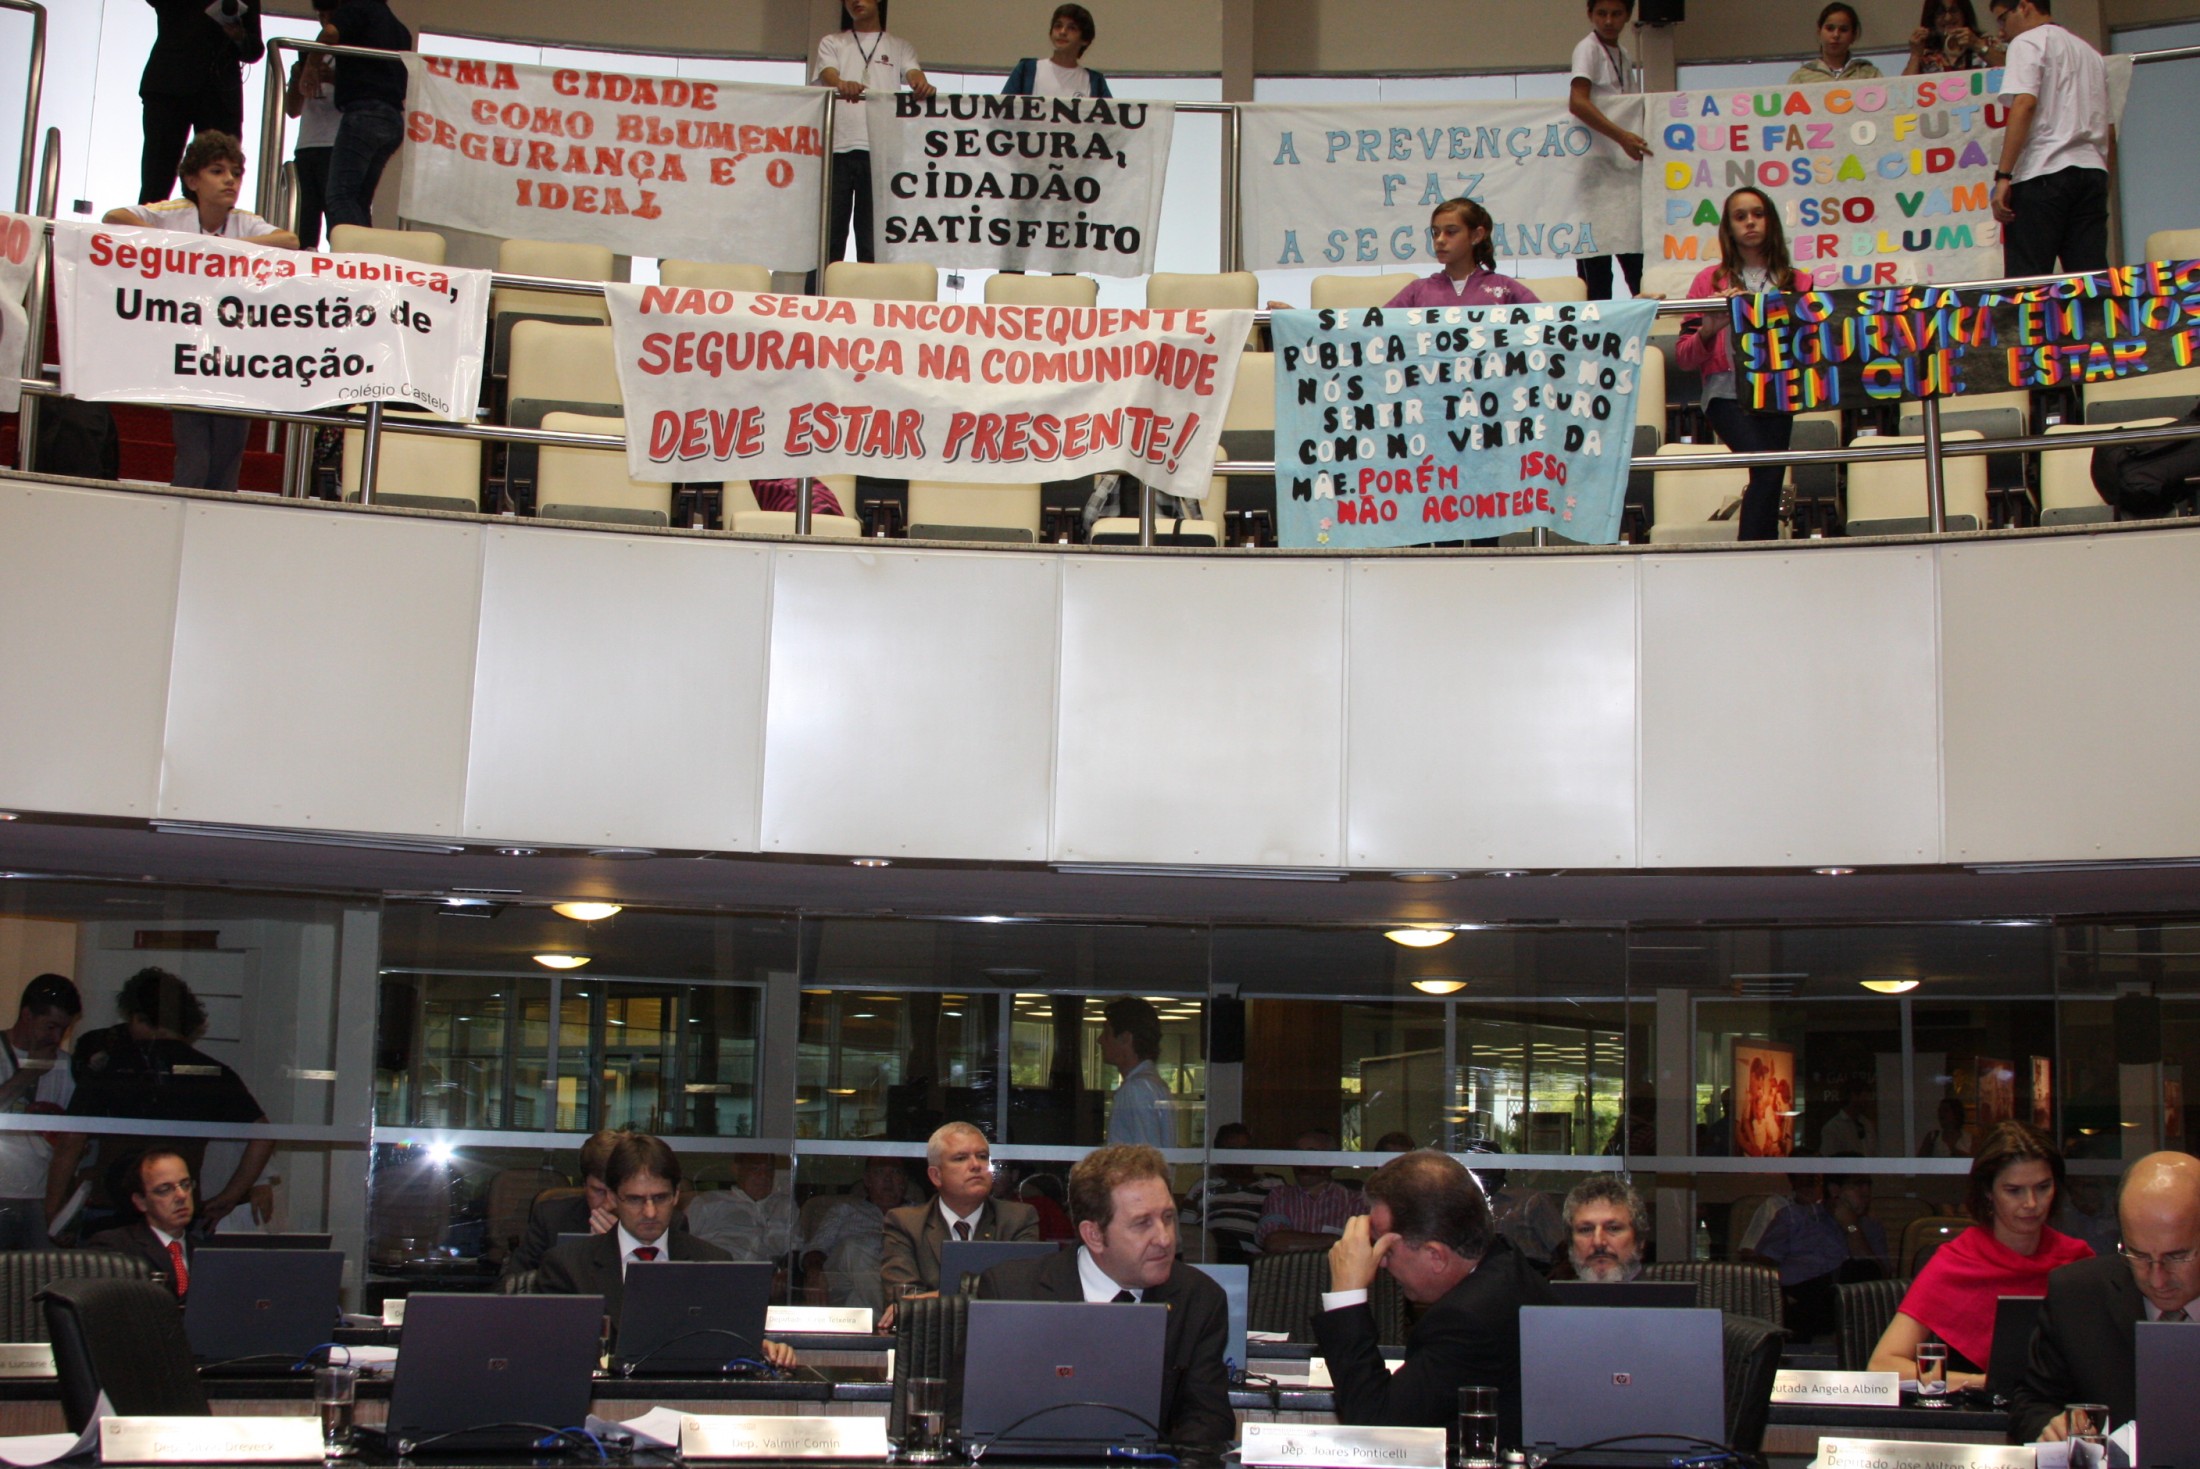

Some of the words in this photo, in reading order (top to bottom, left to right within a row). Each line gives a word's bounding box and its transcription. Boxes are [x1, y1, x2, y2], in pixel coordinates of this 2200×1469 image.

[421, 55, 520, 90] UMA
[552, 69, 719, 111] CIDADE
[471, 99, 594, 140] COMO
[895, 92, 1148, 129] BLUMENAU
[1669, 92, 1689, 118] É
[1701, 95, 1720, 117] A
[1731, 91, 1812, 118] SUA
[407, 111, 687, 186] SEGURANÇA
[710, 152, 748, 187] É
[765, 159, 795, 189] O
[924, 129, 1127, 168] SEGURA,
[1273, 132, 1300, 165] A
[1325, 120, 1592, 166] PREVENÇÃO
[1663, 123, 1750, 152] QUE
[1763, 123, 1834, 152] FAZ
[1850, 120, 1877, 147] O
[1665, 159, 1713, 191] DA
[1726, 153, 1866, 188] NOSSA
[1877, 138, 2001, 180] CIDA
[516, 179, 662, 220] IDEAL
[1382, 171, 1484, 206] FAZ
[1895, 182, 1996, 218] VAM
[1277, 230, 1303, 264] A
[1324, 222, 1599, 262] SEGANÇA
[1664, 233, 1838, 262] MAER
[89, 233, 296, 286] Segurança
[311, 256, 459, 304] Pública,
[1801, 262, 1934, 287] GURA!
[116, 287, 204, 326] Uma
[217, 295, 377, 329] Questão
[390, 301, 432, 334] de
[749, 294, 857, 325] SEJA
[873, 302, 1217, 345] INCONSEQUENTE,
[1318, 308, 1349, 330] SE
[1362, 306, 1384, 327] A
[1406, 303, 1600, 326] SEGURANÇA
[1856, 286, 1962, 315] SEJA
[2019, 298, 2085, 346] EM
[174, 344, 375, 387] Educação.
[637, 330, 902, 382] SEGURANÇA
[918, 344, 970, 380] NA
[980, 341, 1219, 397] COMUNIDADE
[1284, 336, 1405, 371] PÚBLICA
[1523, 324, 1641, 365] SEGURA
[1298, 372, 1364, 405] NÓS
[1385, 350, 1566, 395] DEVERÍAMOS
[1577, 359, 1633, 395] NOS
[1746, 365, 1840, 411] TEM
[1861, 345, 1967, 399] QUE
[2007, 339, 2149, 387] ESTAR
[339, 384, 395, 400] Colégio
[401, 383, 449, 413] Castelo
[1323, 399, 1424, 433] SENTIR
[1512, 383, 1611, 421] SEGURO
[649, 404, 766, 465] DEVE
[784, 401, 928, 462] ESTAR
[942, 405, 1201, 475] PRESENTE!
[1299, 435, 1375, 465] COMO
[1387, 433, 1426, 459] NO
[1447, 414, 1547, 452] VENTRE
[1564, 424, 1602, 457] DA
[1358, 454, 1458, 494] PORÉM
[1519, 450, 1567, 487] ISSO
[1422, 488, 1556, 523] ACONTECE.
[1772, 1384, 1808, 1394] utada
[1812, 1384, 1849, 1395] Angela
[1853, 1384, 1889, 1394] Albino
[732, 1438, 759, 1450] Dep.
[763, 1438, 799, 1449] Valmir
[804, 1438, 840, 1449] Comin
[1281, 1445, 1307, 1457] Dep.
[1313, 1445, 1349, 1457] Joares
[1353, 1446, 1407, 1459] Ponticelli
